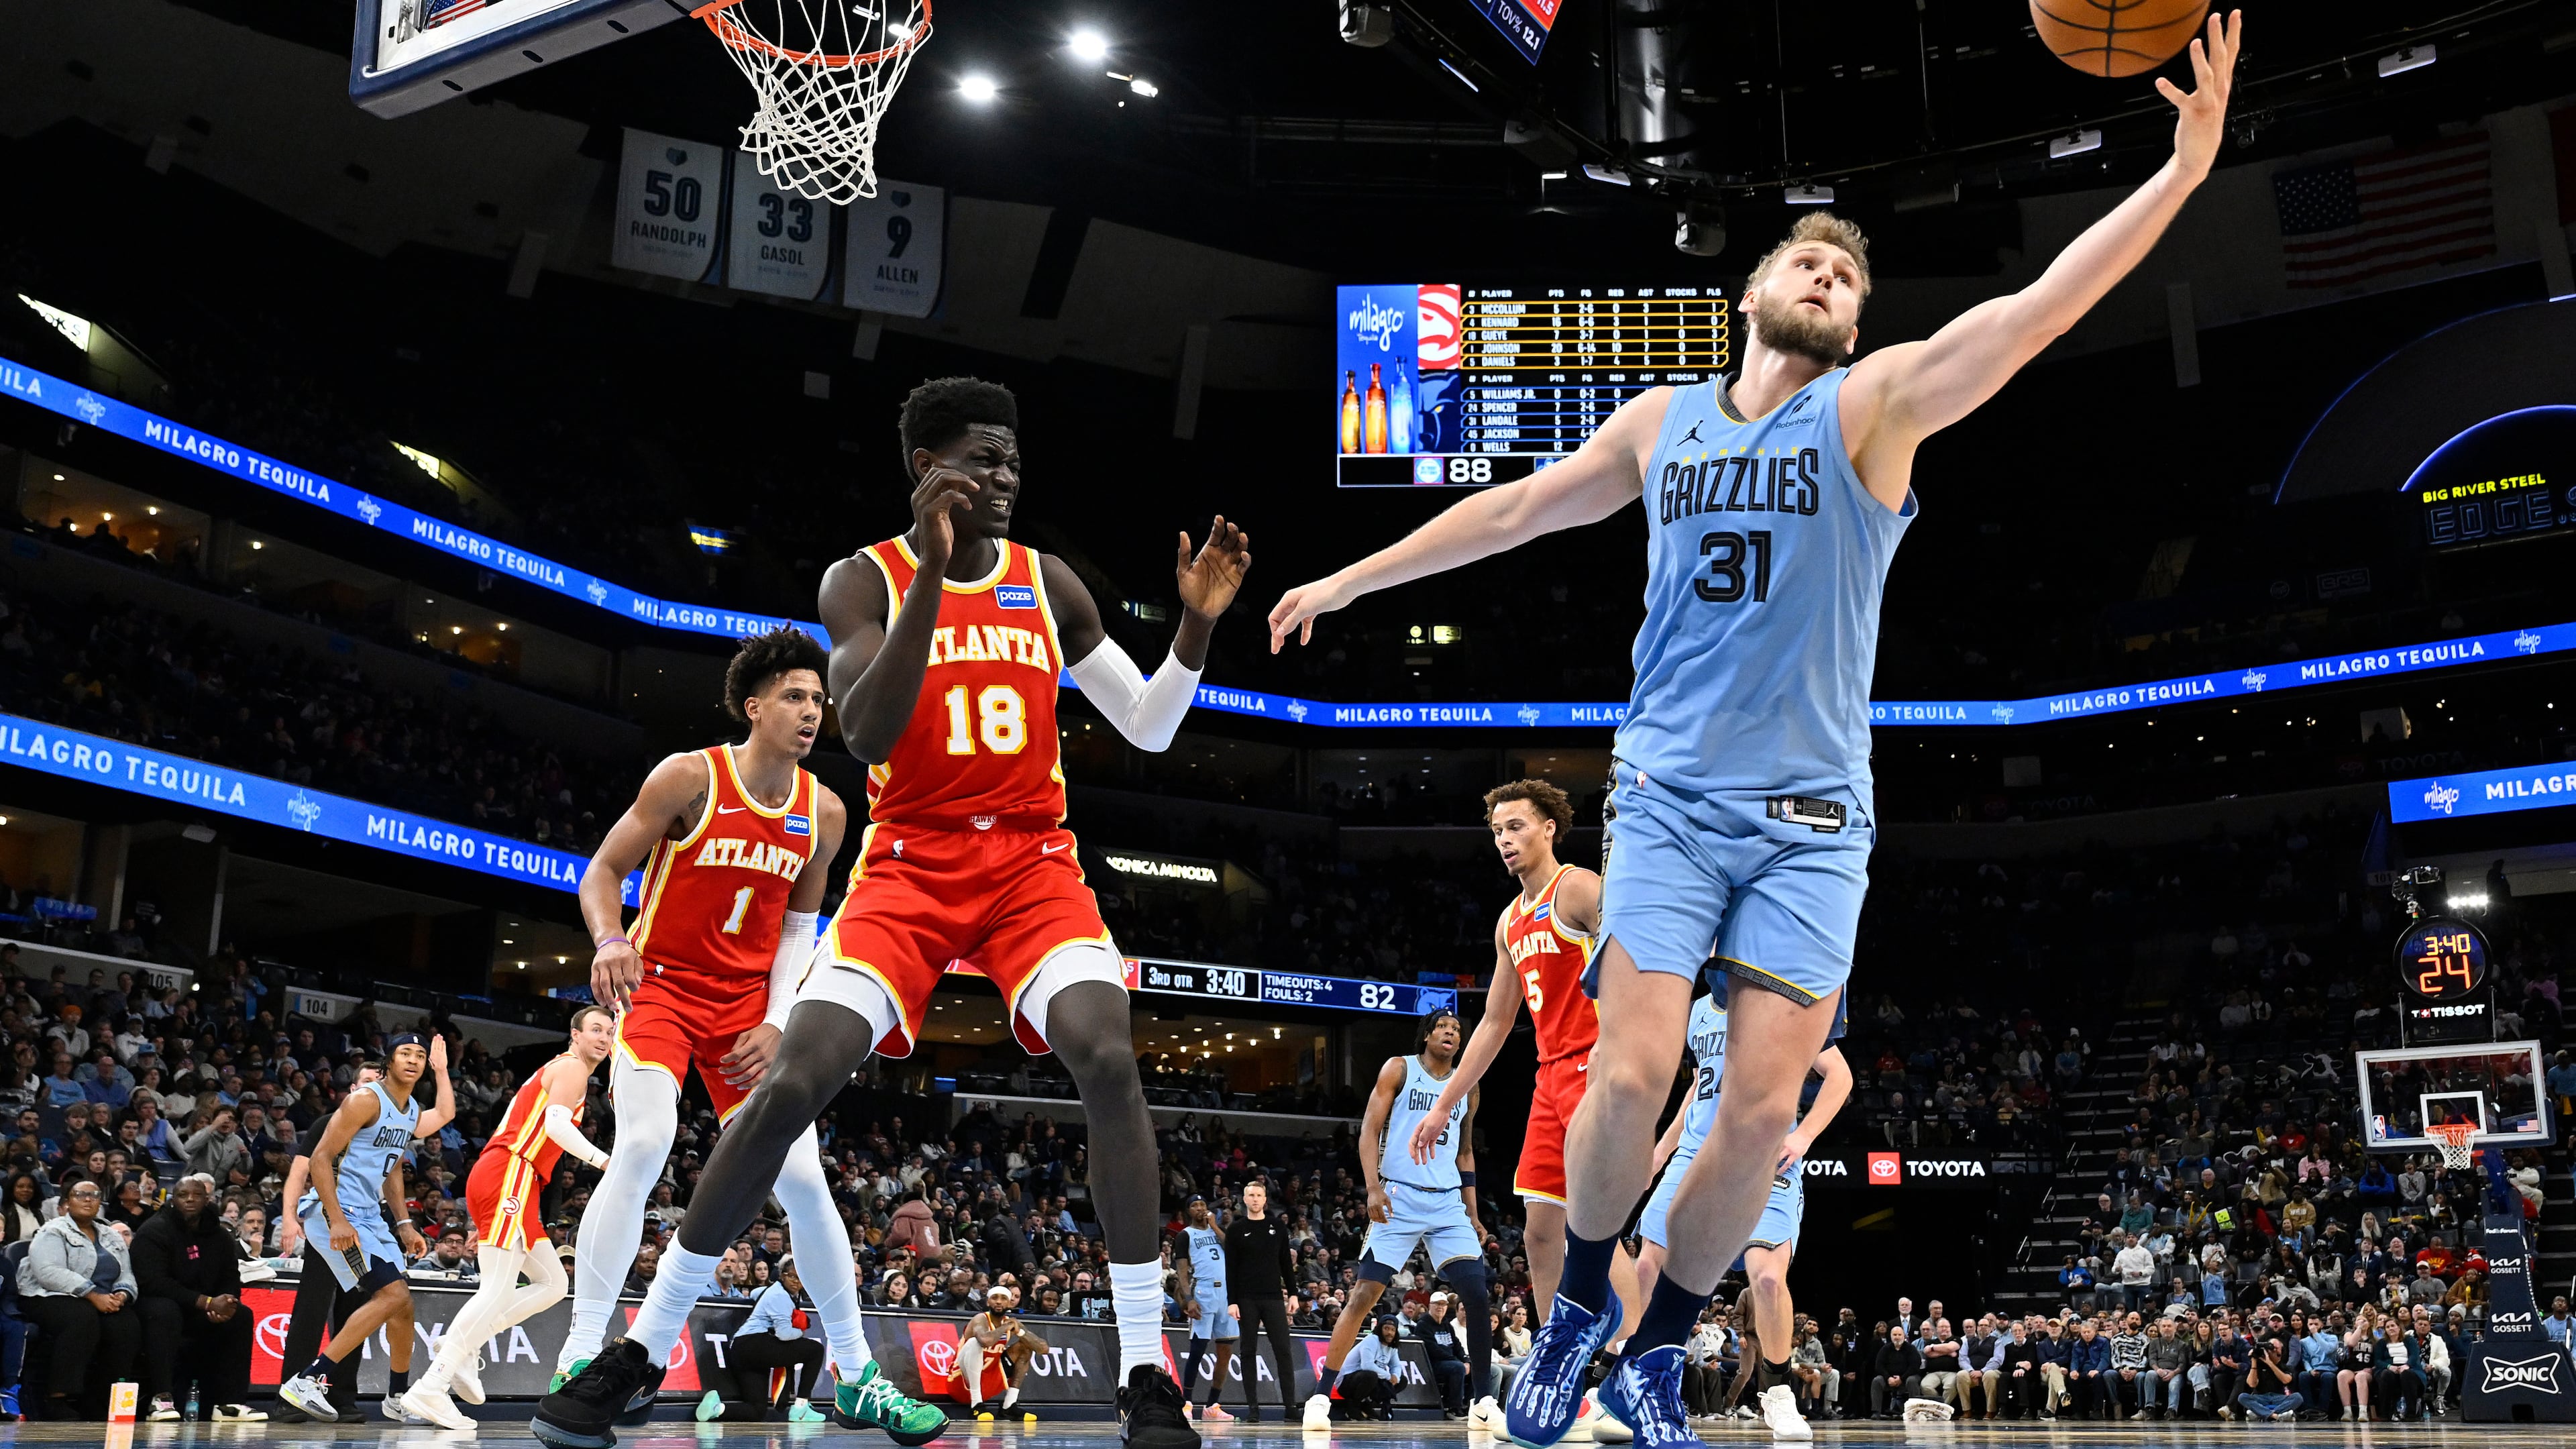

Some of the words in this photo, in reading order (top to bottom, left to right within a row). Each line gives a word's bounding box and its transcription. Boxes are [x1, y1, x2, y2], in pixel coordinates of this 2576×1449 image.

[1498, 1, 1523, 33] TOV%
[1522, 25, 1540, 50] 12.1
[644, 170, 702, 222] 50
[758, 193, 814, 242] 33
[631, 221, 707, 248] RANDOLPH
[886, 216, 912, 259] 9
[761, 245, 804, 266] GASOL
[877, 264, 918, 284] ALLEN
[1481, 289, 1513, 298] PLAYER
[1548, 289, 1564, 298] PTS
[1638, 288, 1654, 297] AST
[1665, 288, 1697, 297] STOCKS
[1706, 288, 1721, 297] FLS
[1469, 305, 1475, 315] 3
[1481, 303, 1526, 315] MCCOLLUM
[1612, 302, 1620, 314] 0
[1643, 303, 1650, 313] 3
[1679, 303, 1684, 313] 1
[1711, 302, 1717, 313] 1
[1350, 293, 1405, 352] milagro
[1469, 318, 1475, 327] 4
[1481, 316, 1519, 327] KENNARD
[1613, 315, 1620, 327] 3
[1644, 315, 1648, 326] 1
[1679, 315, 1684, 326] 1
[1711, 315, 1718, 326] 0
[1481, 329, 1507, 341] GUEYE
[1554, 329, 1560, 340] 7
[1579, 329, 1594, 340] 3-7
[1613, 328, 1621, 340] 0
[1644, 329, 1649, 339] 1
[1678, 328, 1686, 339] 0
[1711, 328, 1718, 339] 3
[1470, 344, 1474, 354] 1
[1481, 343, 1520, 354] JOHNSON
[1551, 342, 1563, 354] 20
[1611, 341, 1622, 353] 10
[1644, 341, 1650, 353] 7
[1678, 341, 1686, 352] 0
[1713, 341, 1717, 352] 1
[1469, 358, 1475, 367] 5
[1481, 356, 1515, 367] DANIELS
[1554, 356, 1560, 367] 3
[1580, 355, 1593, 366] 1-7
[1613, 355, 1620, 366] 4
[1644, 355, 1650, 366] 5
[1678, 354, 1686, 366] 0
[1712, 354, 1719, 366] 2
[1482, 374, 1513, 383] PLAYER
[1549, 374, 1566, 382] PTS
[1639, 374, 1655, 382] AST
[1666, 373, 1699, 382] STOCKS
[1470, 390, 1476, 400] 5
[1481, 389, 1523, 400] WILLIAMS
[1523, 389, 1536, 400] JR.
[1554, 388, 1561, 400] 0
[1579, 388, 1595, 399] 0-2
[1613, 388, 1621, 399] 0
[1482, 402, 1517, 413] SPENCER
[1554, 402, 1560, 412] 7
[1580, 401, 1595, 412] 2-6
[1468, 417, 1477, 426] 31
[1482, 415, 1518, 426] LANDALE
[1554, 415, 1561, 426] 5
[1776, 416, 1817, 430] Robinhood
[1468, 429, 1478, 439] 45
[1482, 429, 1519, 439] JACKSON
[1554, 428, 1562, 439] 9
[1470, 443, 1477, 452] 0
[1482, 441, 1510, 452] WELLS
[1554, 441, 1563, 451] 12
[1450, 458, 1492, 483] 88
[1660, 448, 1819, 526] GRIZZLIES
[2422, 489, 2449, 504] BIG
[2451, 480, 2497, 498] RIVER
[2499, 473, 2546, 491] STEEL
[145, 419, 239, 468] MILAGRO
[248, 456, 330, 502] TEQUILA
[413, 518, 490, 559] MILAGRO
[497, 548, 565, 587] TEQUILA
[633, 598, 717, 629] MILAGRO
[2428, 490, 2553, 545] EDGE
[1694, 531, 1772, 602] 31
[999, 590, 1032, 603] paze
[926, 625, 1051, 675] TLANTA
[1892, 706, 1966, 720] TEQUILA
[2049, 692, 2130, 715] MILAGRO
[2136, 679, 2215, 703] TEQUILA
[2301, 655, 2390, 680] MILAGRO
[2396, 642, 2485, 666] TEQUILA
[1199, 688, 1266, 712] TEQUILA
[1335, 708, 1413, 722] MILAGRO
[1419, 708, 1493, 722] TEQUILA
[945, 684, 1028, 755] 18
[0, 724, 113, 773] ILAGRO
[125, 755, 246, 806] TEQUILA
[367, 814, 476, 859] MILAGRO
[484, 842, 577, 885] TEQUILA
[2424, 781, 2460, 814] milagro
[2485, 775, 2576, 801] MILAGR
[786, 818, 808, 830] paze
[969, 814, 998, 824] HAWKS
[1159, 862, 1218, 883] MINOLTA
[722, 885, 755, 935] 1
[2424, 933, 2471, 956] 3:40
[1148, 970, 1171, 987] 3RD
[1174, 974, 1193, 989] QTR
[1206, 968, 1246, 997] 3:40
[1265, 974, 1324, 991] TIMEOUTS:
[1324, 980, 1333, 991] 4
[2418, 954, 2471, 994] 24
[1265, 988, 1303, 1002] FOULS:
[1305, 991, 1313, 1002] 2
[1360, 983, 1397, 1010] 82
[1523, 969, 1544, 1014] 5
[306, 999, 328, 1016] 104
[2430, 1004, 2485, 1018] TISSOT
[1906, 1161, 1986, 1177] TOYOTA
[1209, 1248, 1220, 1260] 3
[2490, 1267, 2521, 1275] GOSSETT
[2492, 1324, 2532, 1334] GOSSETT
[2355, 1352, 2371, 1363] 45
[2491, 1366, 2550, 1382] SONIC
